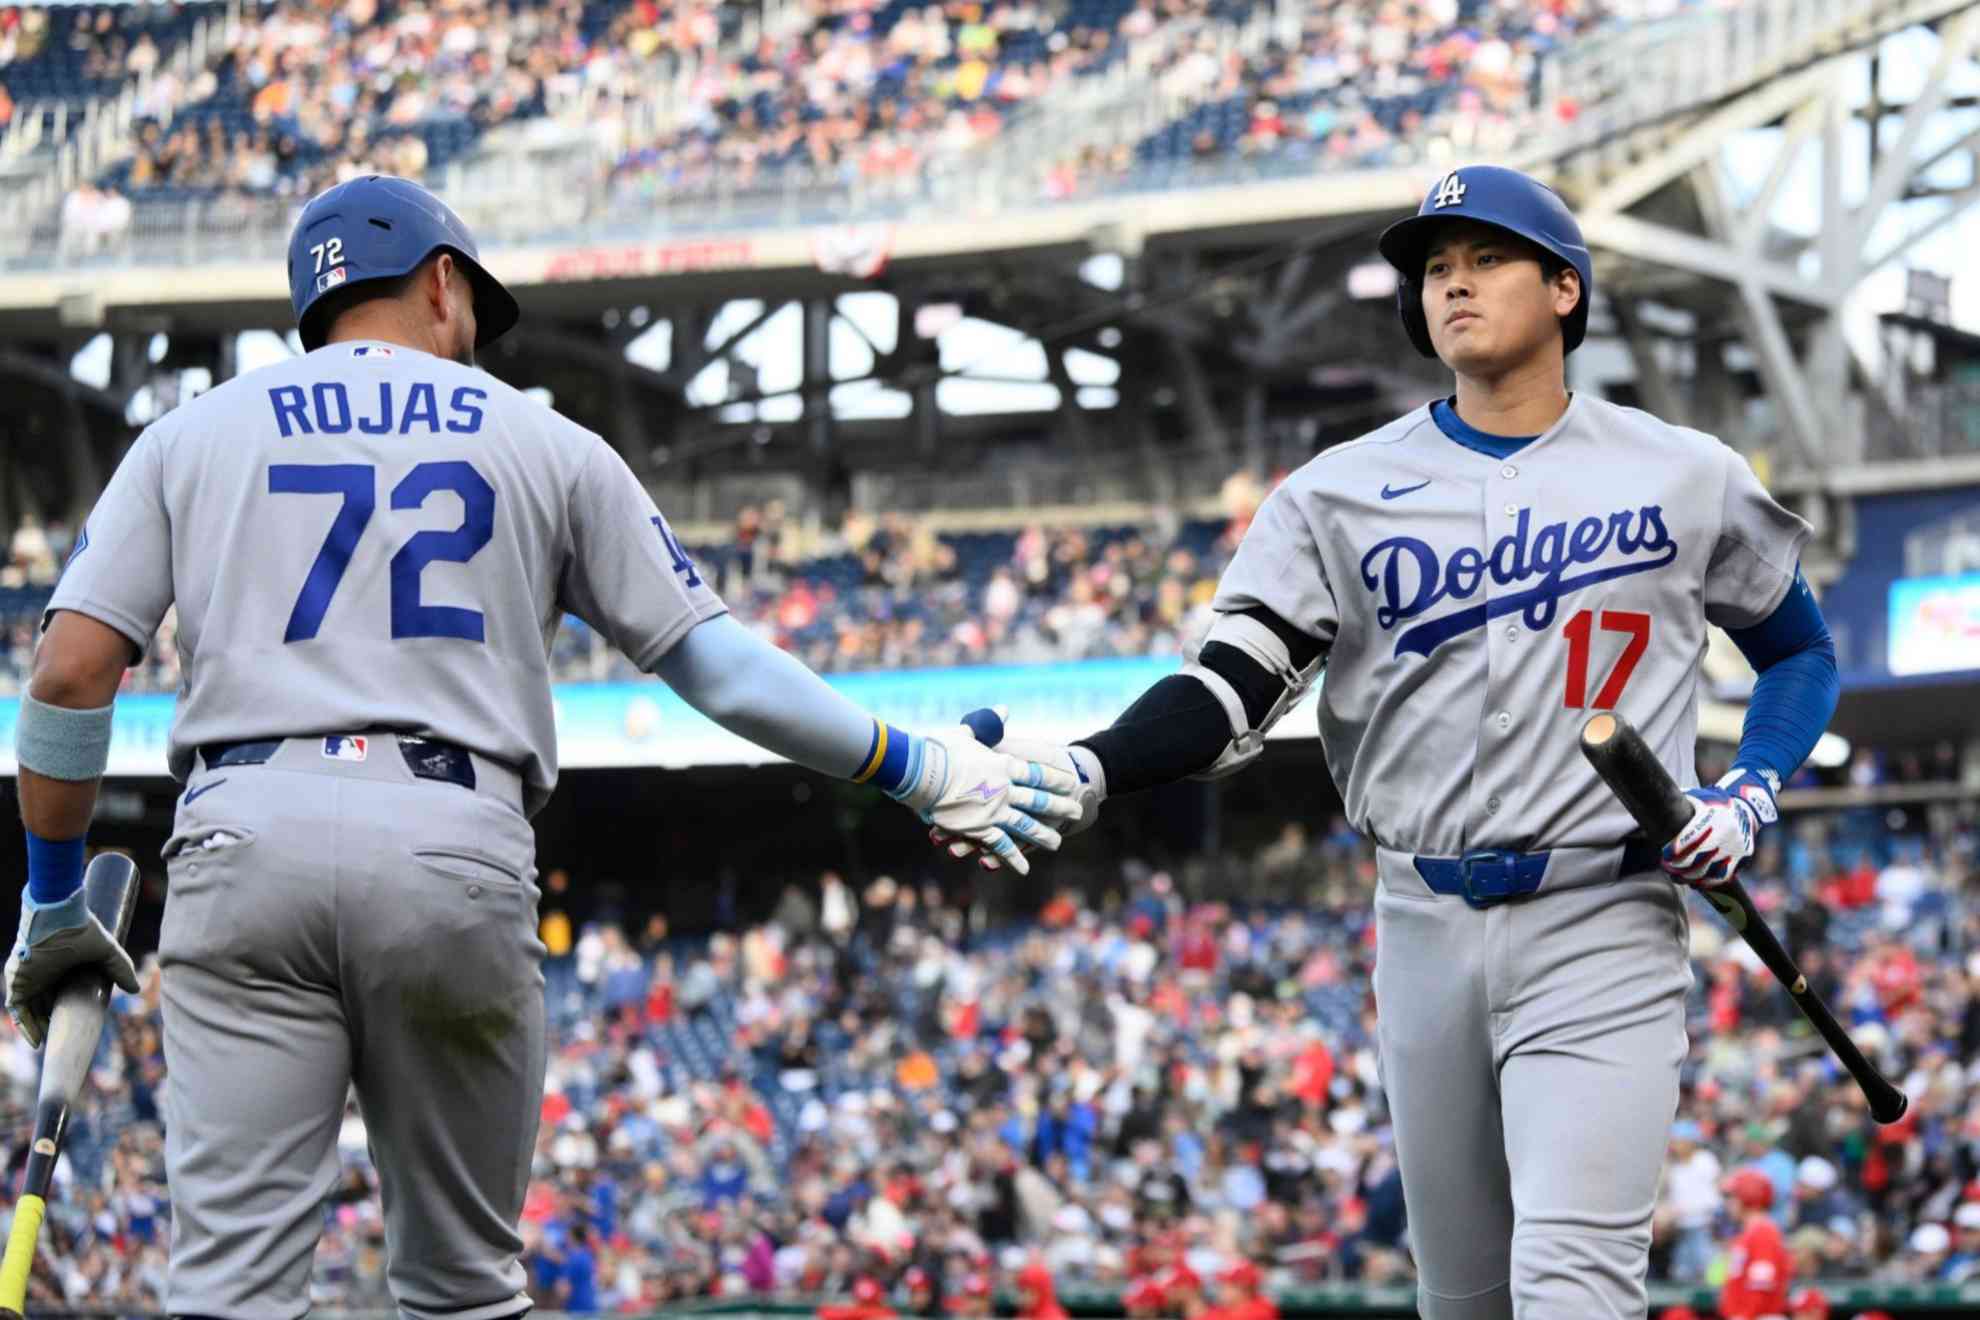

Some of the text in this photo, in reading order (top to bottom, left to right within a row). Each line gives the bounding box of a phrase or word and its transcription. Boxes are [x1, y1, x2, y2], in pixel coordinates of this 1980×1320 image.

[1434, 174, 1466, 208] LA
[310, 238, 345, 274] 72
[268, 382, 488, 438] ROJAS
[268, 460, 496, 644] 72
[1360, 505, 1678, 632] Dodgers
[1563, 609, 1651, 710] 17
